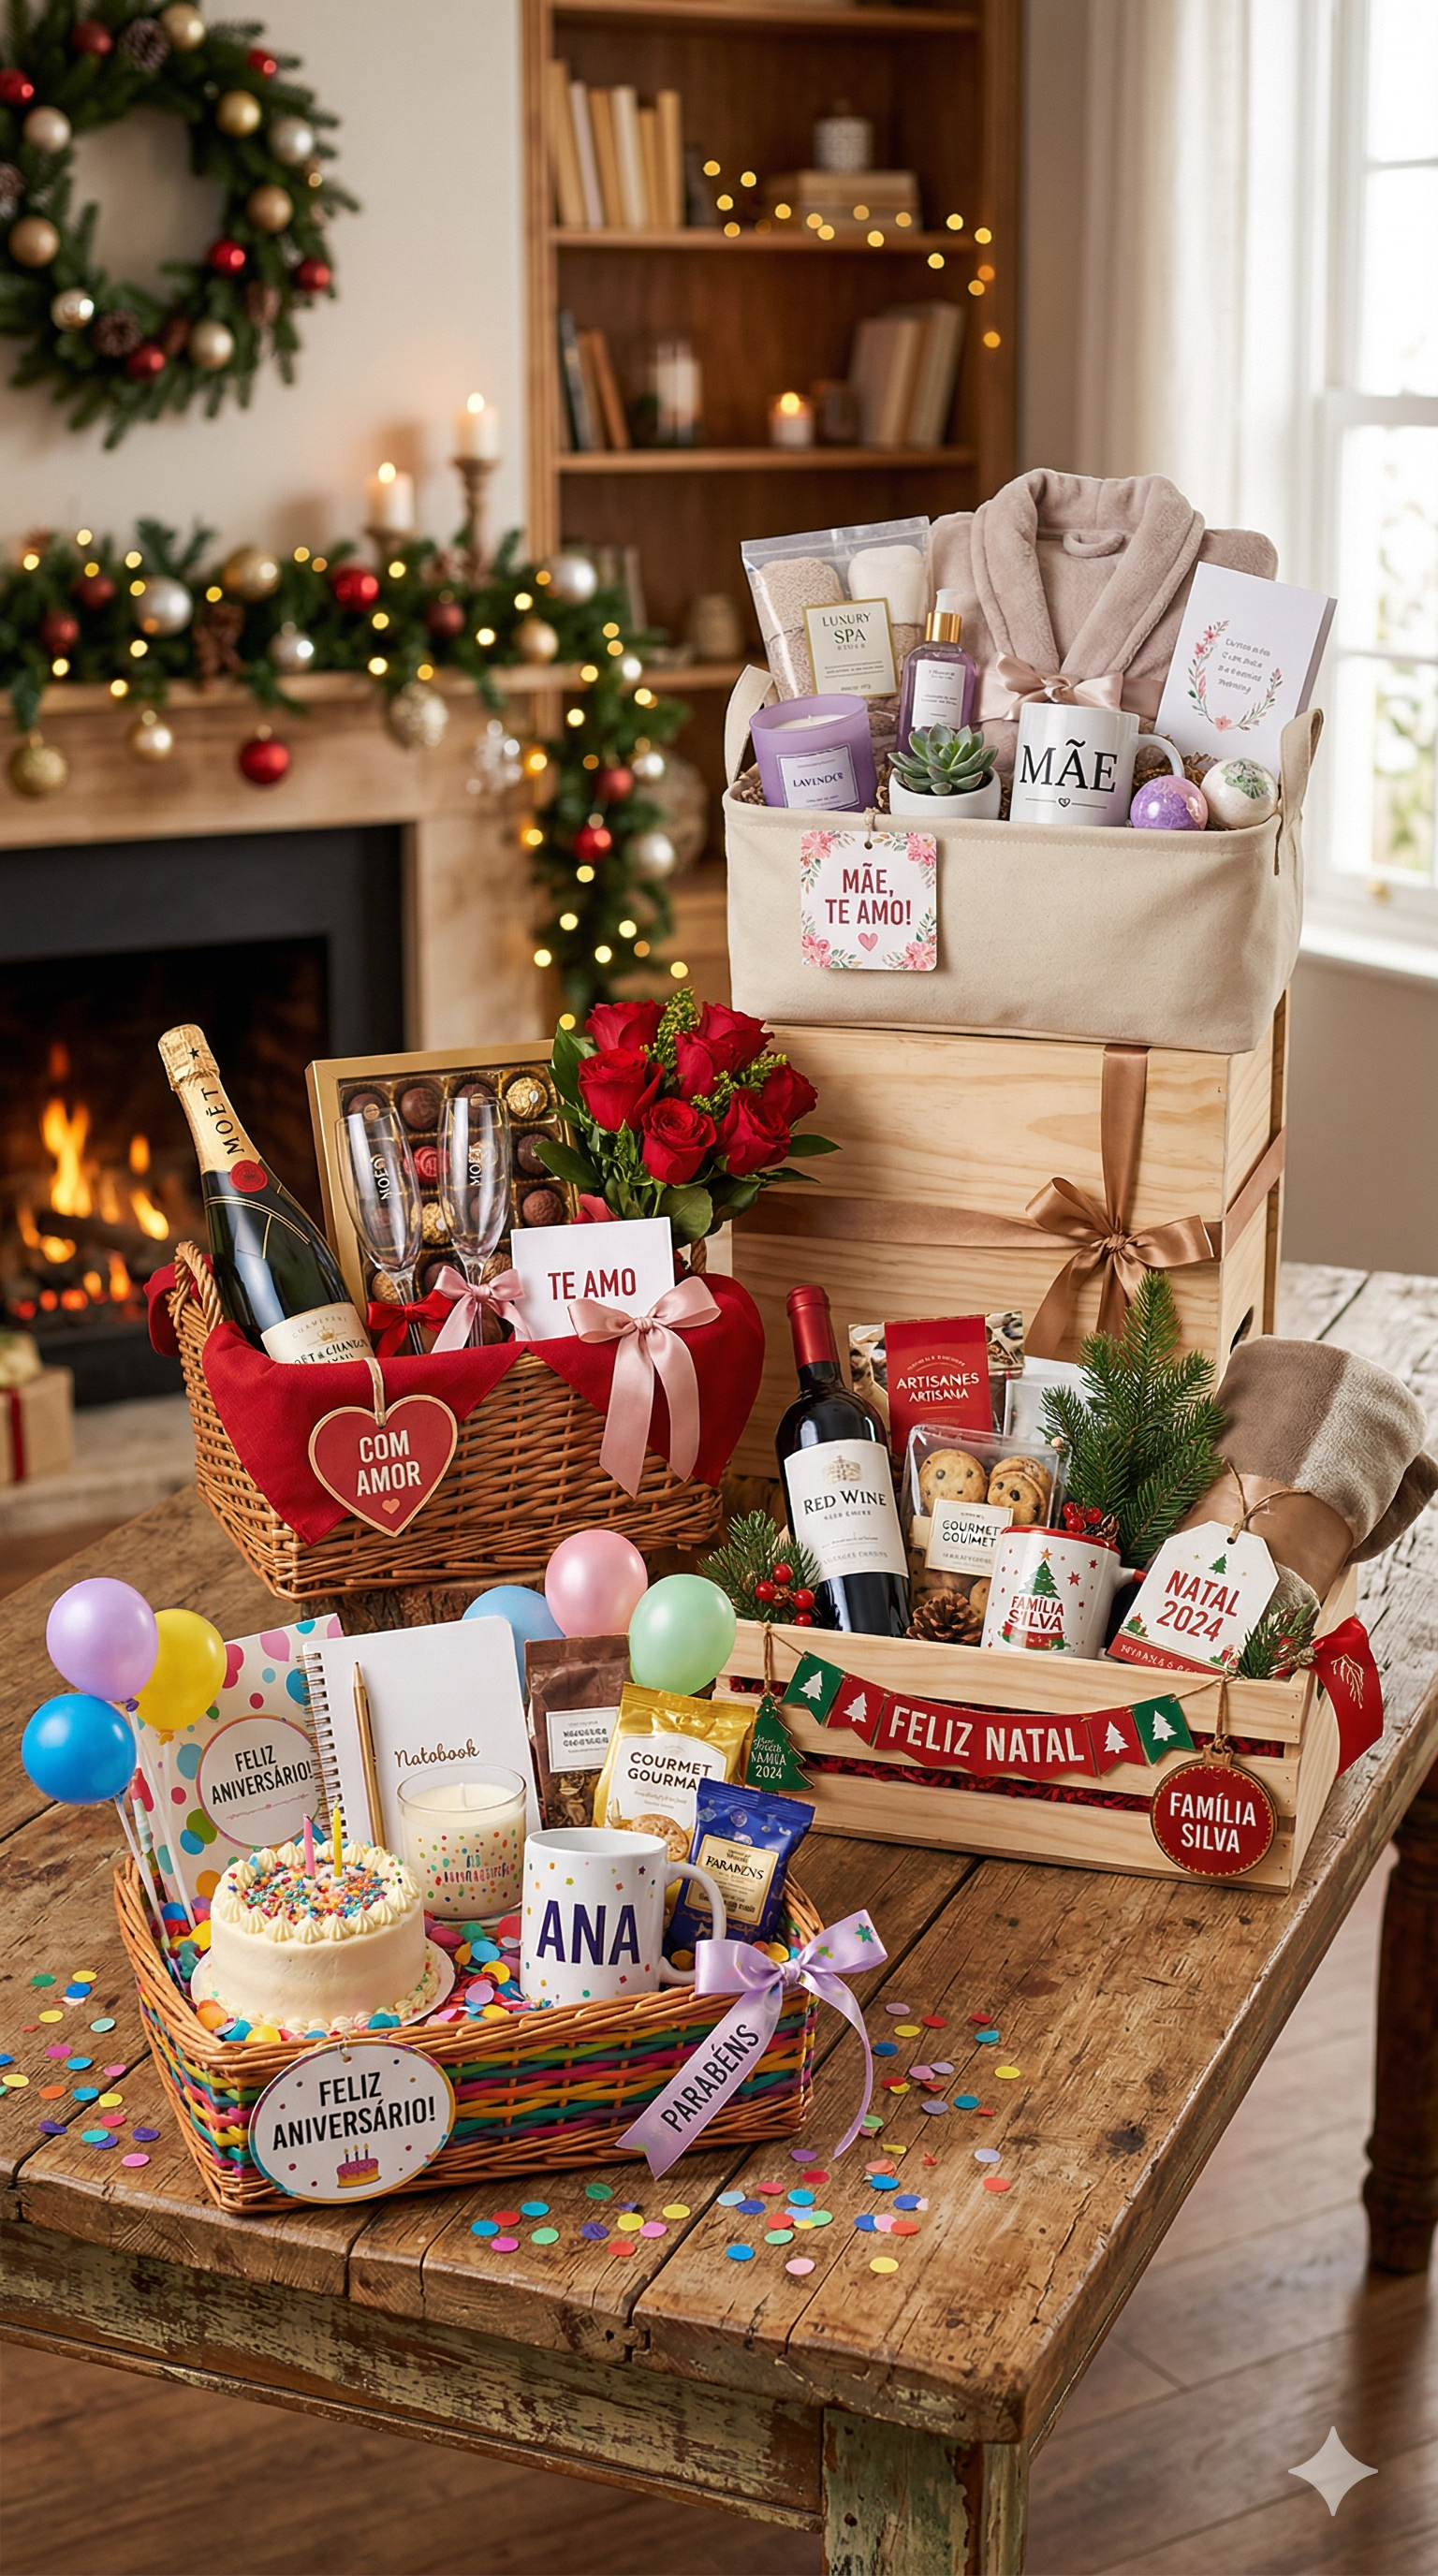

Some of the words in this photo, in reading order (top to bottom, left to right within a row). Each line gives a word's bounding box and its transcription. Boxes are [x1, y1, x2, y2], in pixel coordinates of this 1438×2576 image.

[822, 612, 872, 627] LUXURY
[833, 628, 867, 644] SPA
[1020, 739, 1118, 793] MÃE
[843, 863, 894, 897] MÃE,
[825, 899, 850, 924] TE
[857, 900, 912, 925] AMO!
[548, 1271, 576, 1300] TE
[583, 1267, 637, 1298] AMO
[896, 1372, 980, 1389] ARTISANES
[359, 1429, 410, 1463] COM
[356, 1460, 422, 1497] AMOR
[803, 1495, 837, 1515] RED
[840, 1489, 887, 1506] WINE
[1165, 1569, 1240, 1617] NATAL
[1008, 1609, 1063, 1632] SILVA
[1156, 1600, 1225, 1643] 2024
[888, 1704, 973, 1757] FELIZ
[986, 1725, 1085, 1763] NATAL
[234, 1745, 277, 1773] FELIZ
[756, 1764, 783, 1779] 2024
[212, 1760, 314, 1805] ANIVERSÁRIO!
[1169, 1792, 1256, 1827] FAMÍLIA
[1181, 1822, 1240, 1853] SILVA
[536, 1899, 641, 1966] ANA
[318, 2071, 382, 2106] FELIZ
[660, 2024, 759, 2132] PARABÉNS
[272, 2096, 436, 2151] ANIVERSÁRIO!
